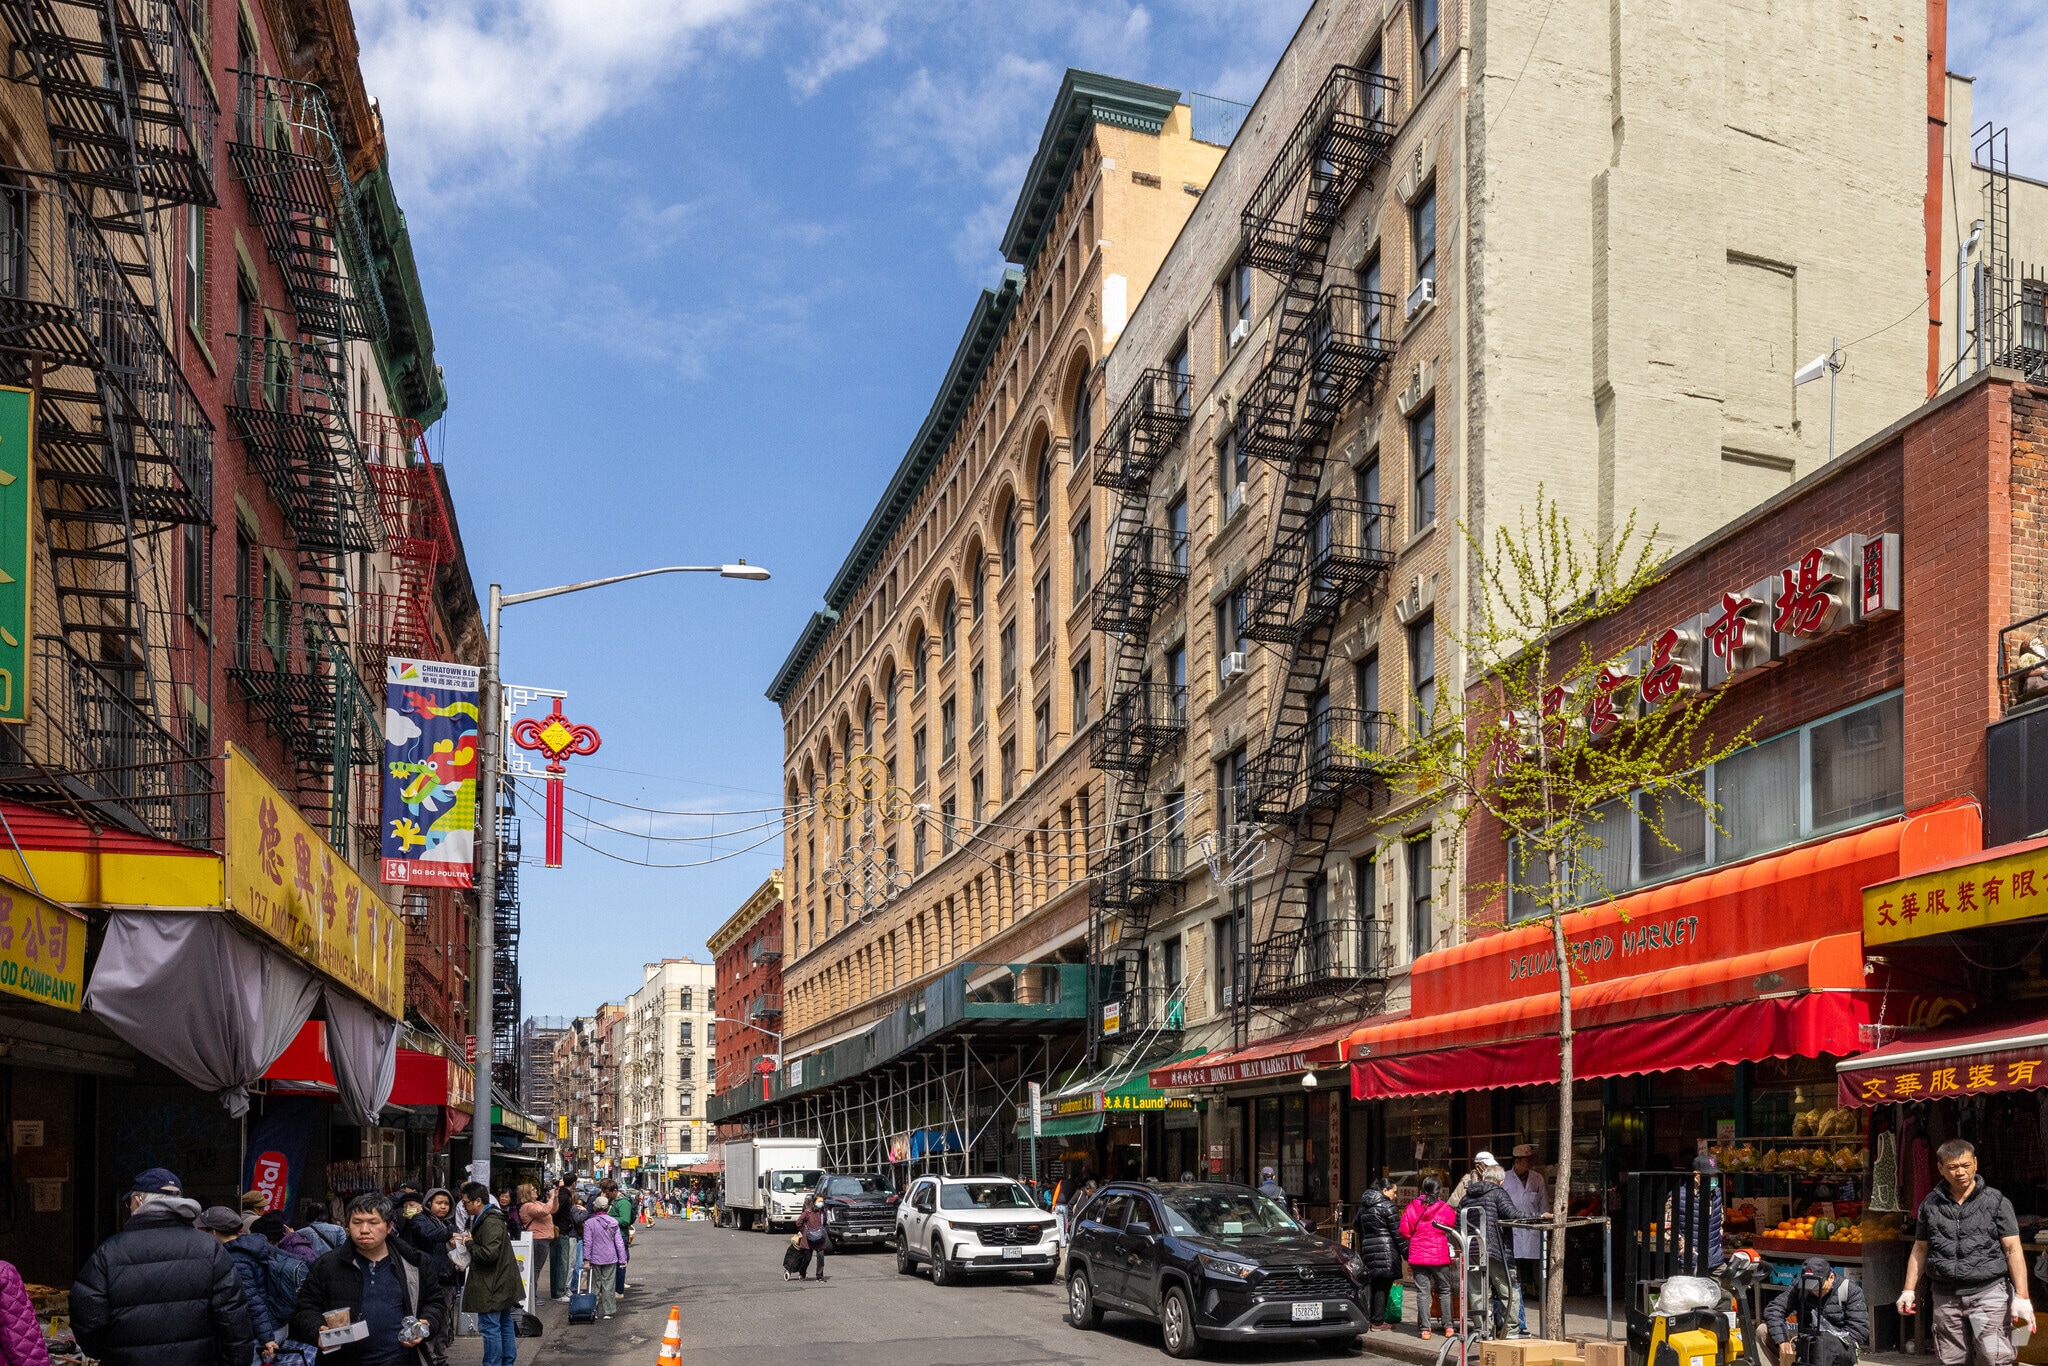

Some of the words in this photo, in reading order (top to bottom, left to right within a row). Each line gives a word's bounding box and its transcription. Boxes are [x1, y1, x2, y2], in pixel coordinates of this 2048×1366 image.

[422, 665, 461, 676] CHINATOWN
[422, 677, 475, 688] 華埠商業改進區
[437, 871, 470, 881] POULTRY
[250, 886, 268, 922] 127
[272, 902, 299, 942] MOTT
[1572, 936, 1614, 969] FOOD
[1622, 915, 1699, 957] MARKET
[21, 966, 76, 1005] COMPANY
[320, 940, 348, 972] AHING
[378, 981, 397, 1010] MARET
[1210, 1066, 1226, 1082] HONG
[1227, 1065, 1236, 1081] LI
[1240, 1060, 1260, 1078] MEAT
[1261, 1055, 1291, 1075] MARKET
[1861, 1059, 2043, 1099] 文華服裝有
[1058, 1098, 1083, 1114] Laundromat
[1103, 1095, 1130, 1109] 洗衣店
[258, 1159, 281, 1211] otal
